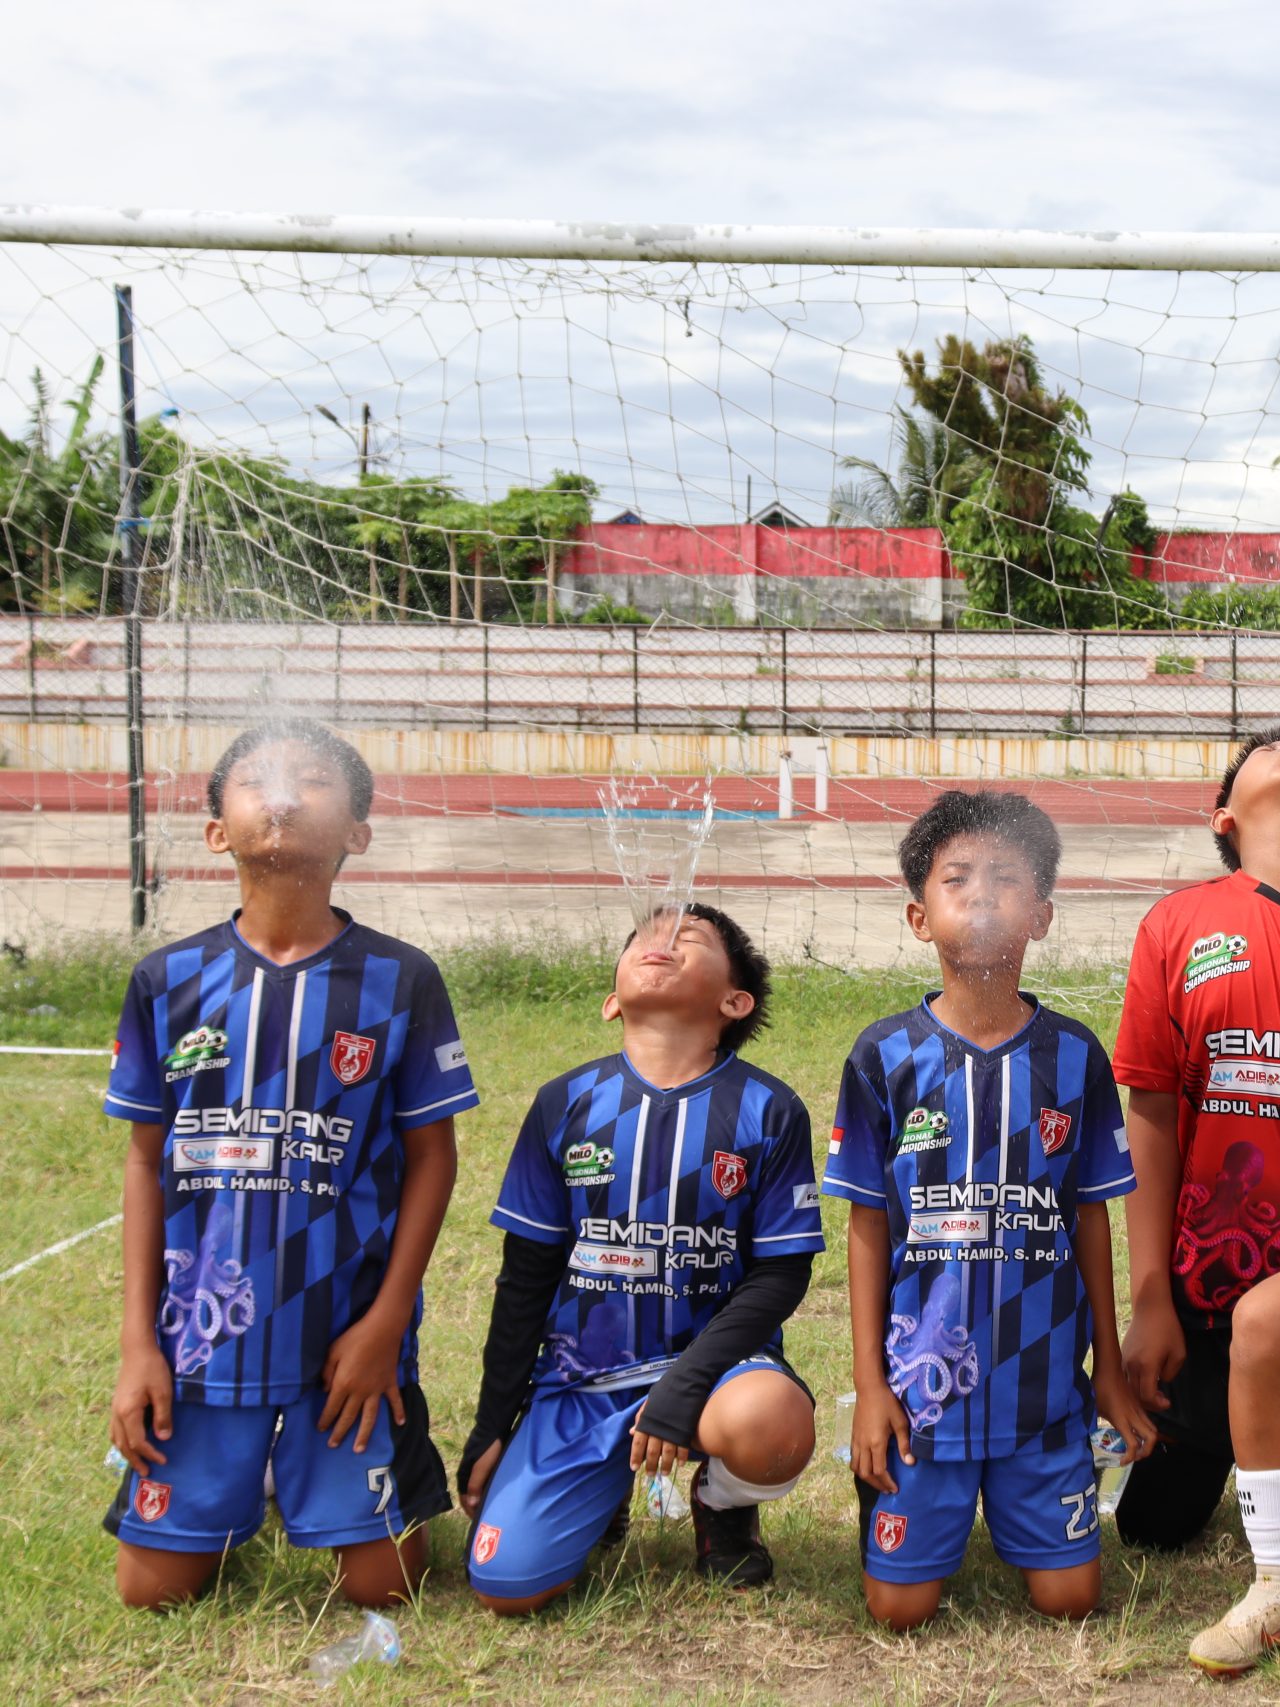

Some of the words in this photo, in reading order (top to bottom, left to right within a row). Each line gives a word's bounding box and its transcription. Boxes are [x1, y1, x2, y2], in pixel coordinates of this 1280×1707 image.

[1194, 939, 1222, 957] MILO
[1190, 956, 1229, 977] REGIONAL
[1184, 960, 1251, 994] CHAMPIONSHIP
[1235, 1069, 1267, 1082] ADIB
[174, 1107, 353, 1143] SEMIDANG
[569, 1149, 592, 1161] MILO
[230, 1177, 296, 1194] HAMID,
[300, 1180, 313, 1194] S.
[599, 1253, 631, 1265] ADIB
[958, 1247, 1009, 1262] HAMID,
[1014, 1248, 1030, 1261] S.
[1035, 1249, 1059, 1261] Pd.
[569, 1274, 618, 1292] ABDUL
[622, 1280, 679, 1300] HAMID,
[683, 1284, 694, 1297] S.
[699, 1283, 722, 1296] Pd.
